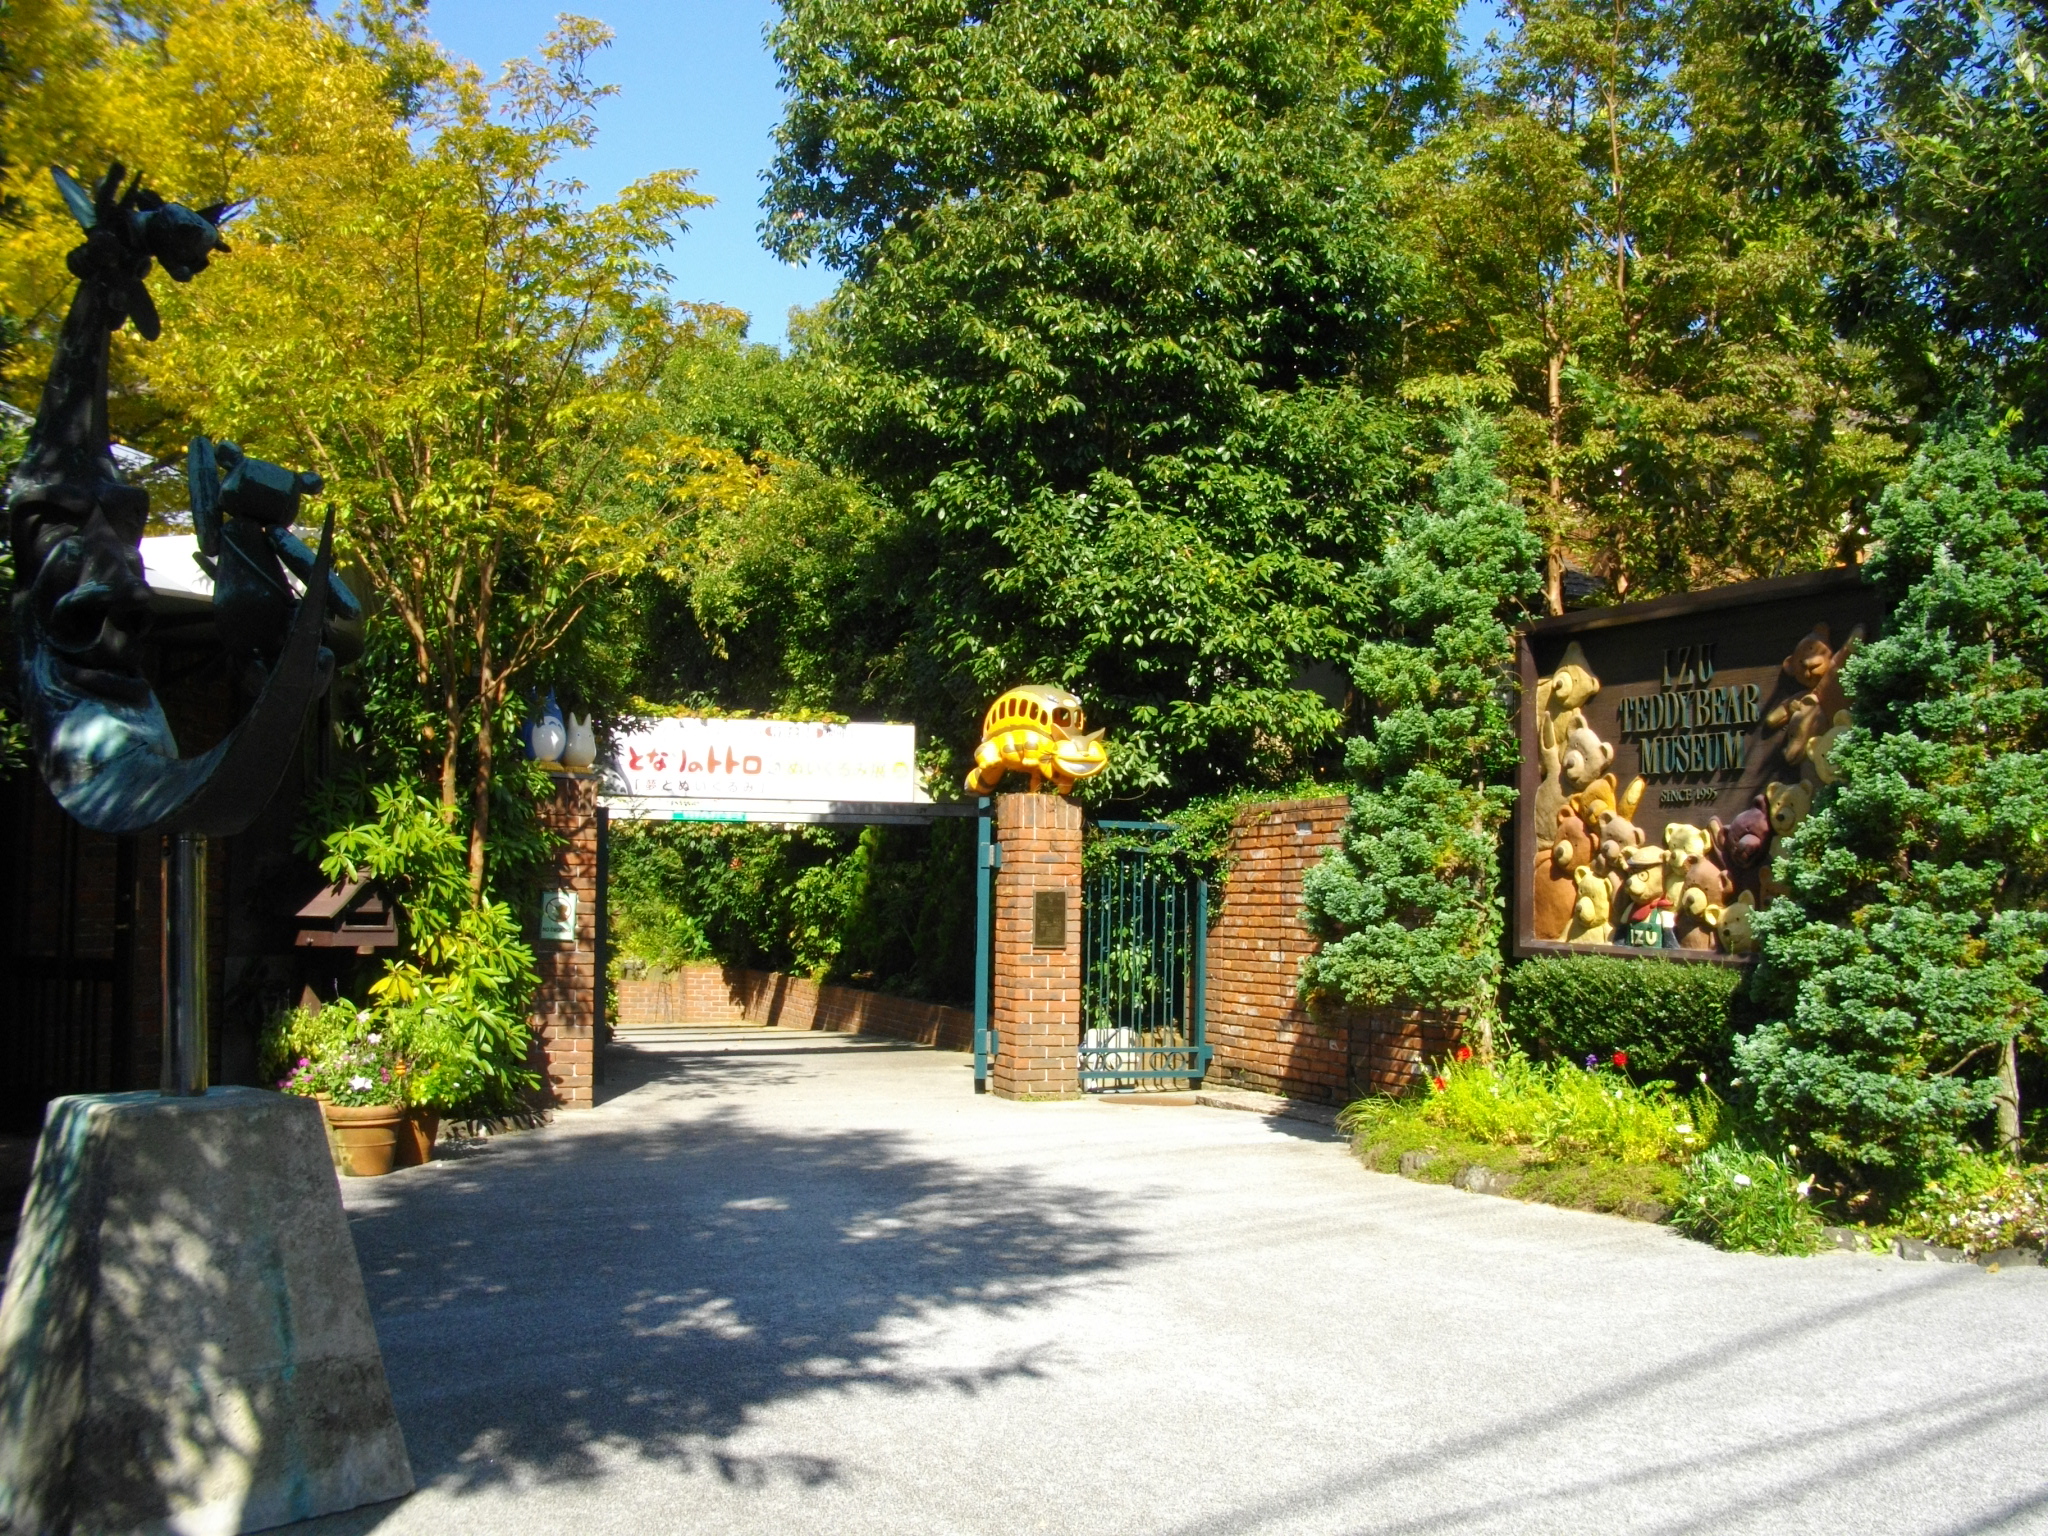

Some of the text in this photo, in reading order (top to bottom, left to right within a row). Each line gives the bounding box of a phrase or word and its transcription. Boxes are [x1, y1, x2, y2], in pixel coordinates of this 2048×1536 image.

[1662, 643, 1714, 687] IZU
[1619, 683, 1761, 733] TEDDY BEAR
[1640, 731, 1745, 775] MUSEUM
[1660, 787, 1718, 803] SINCE 1995
[1630, 928, 1658, 946] IZU
